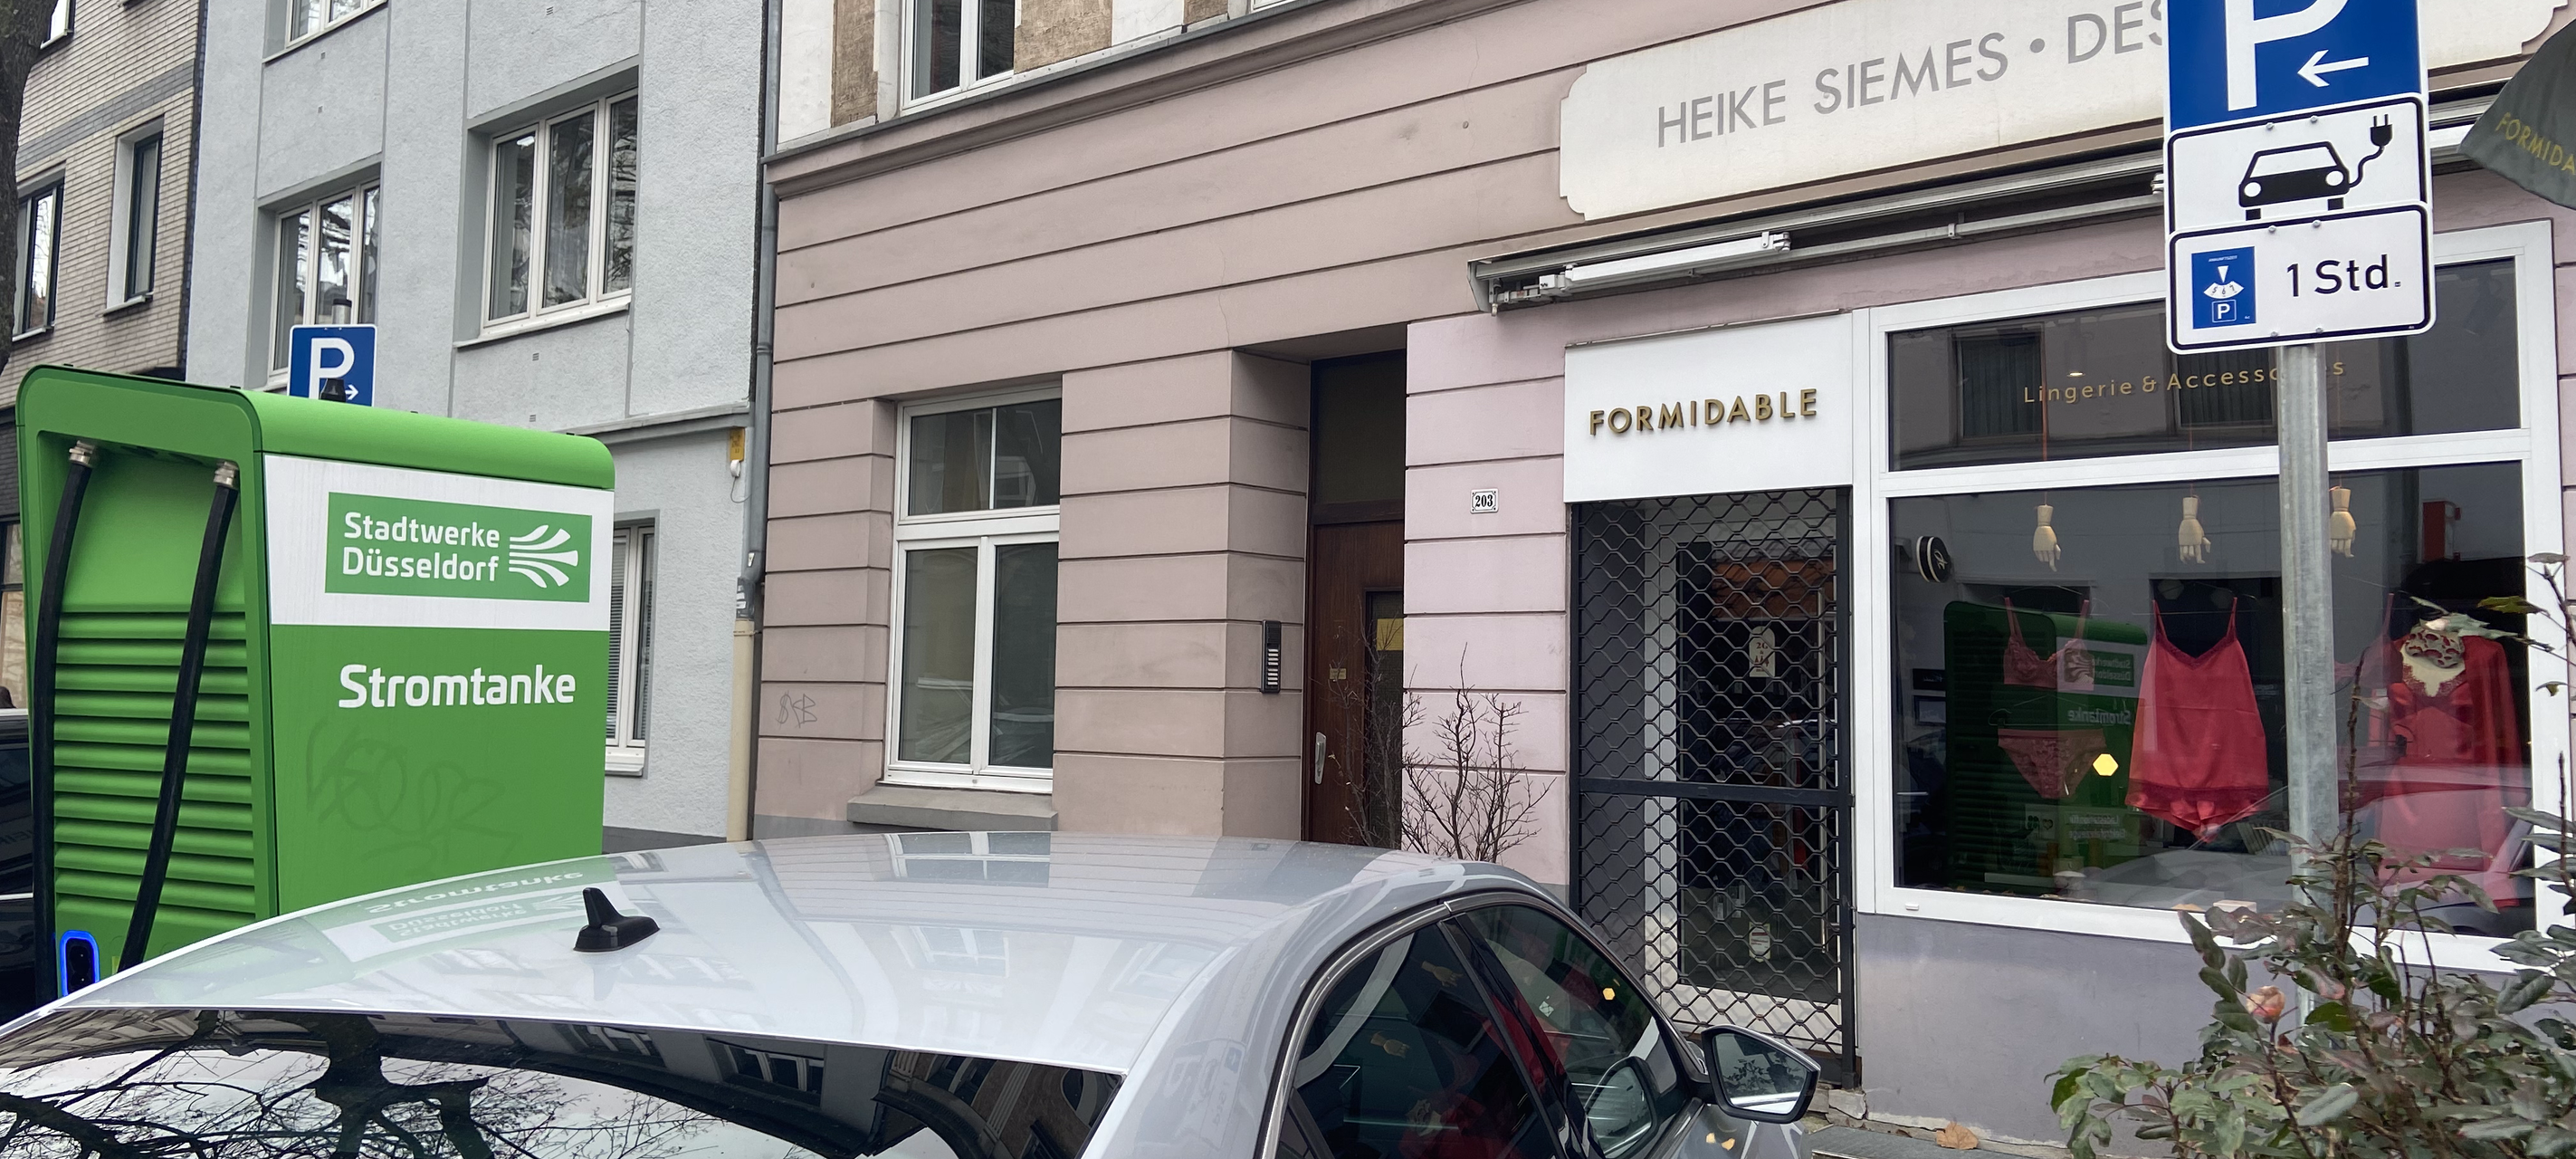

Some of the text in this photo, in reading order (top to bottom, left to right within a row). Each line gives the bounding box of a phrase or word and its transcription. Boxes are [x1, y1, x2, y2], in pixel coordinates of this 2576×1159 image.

[2226, 0, 2349, 111] P
[1657, 79, 1786, 148] HEIKE
[1814, 33, 2008, 115] SIEMES
[2286, 254, 2401, 298] 1 Std.
[2218, 303, 2230, 319] P
[309, 338, 355, 400] P
[2024, 379, 2132, 404] Lingerie
[2142, 376, 2157, 393] &
[1589, 388, 1818, 436] FORMIDABLE
[1474, 494, 1493, 508] 203
[344, 512, 501, 549] Stadtwerke
[342, 546, 500, 582] Düsseldorf
[339, 664, 576, 709] Stromtanke
